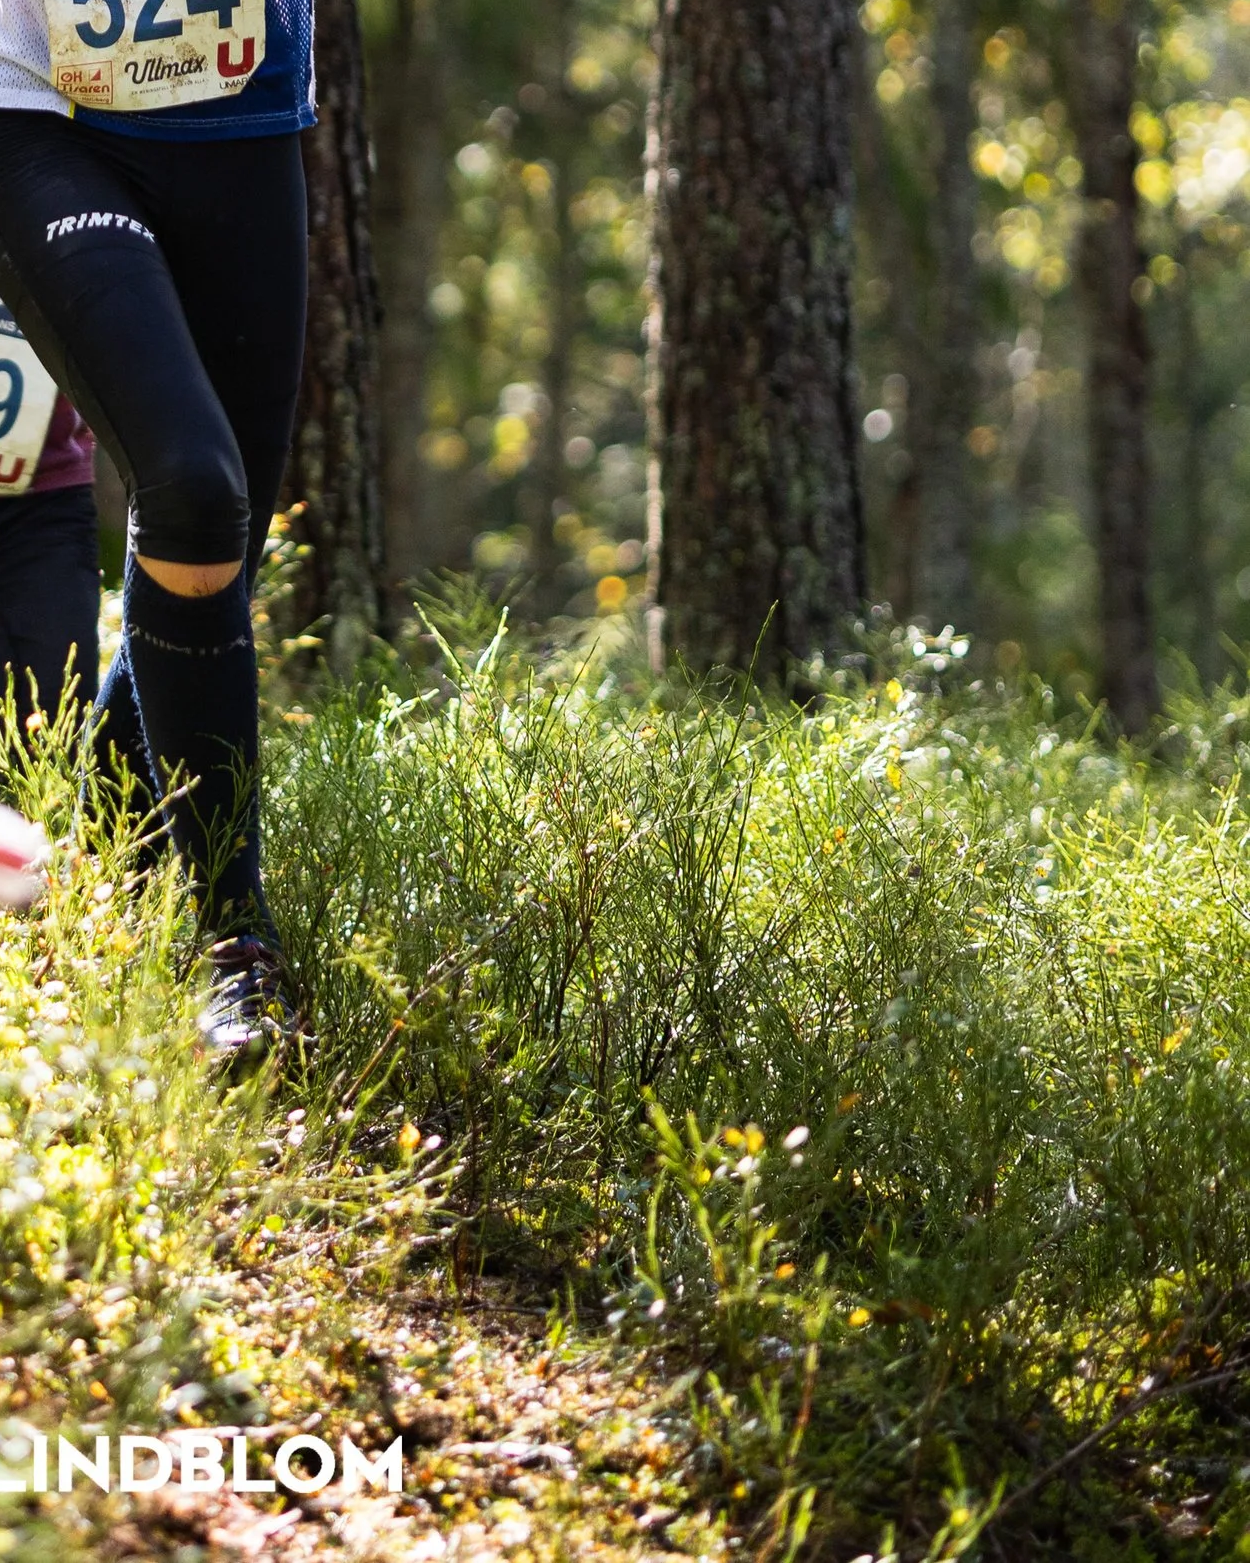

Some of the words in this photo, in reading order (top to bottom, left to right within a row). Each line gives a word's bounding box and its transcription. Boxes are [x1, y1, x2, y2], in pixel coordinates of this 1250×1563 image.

[124, 54, 206, 85] Ullmax
[219, 78, 249, 90] UMAR
[47, 212, 155, 243] TRIMTEX
